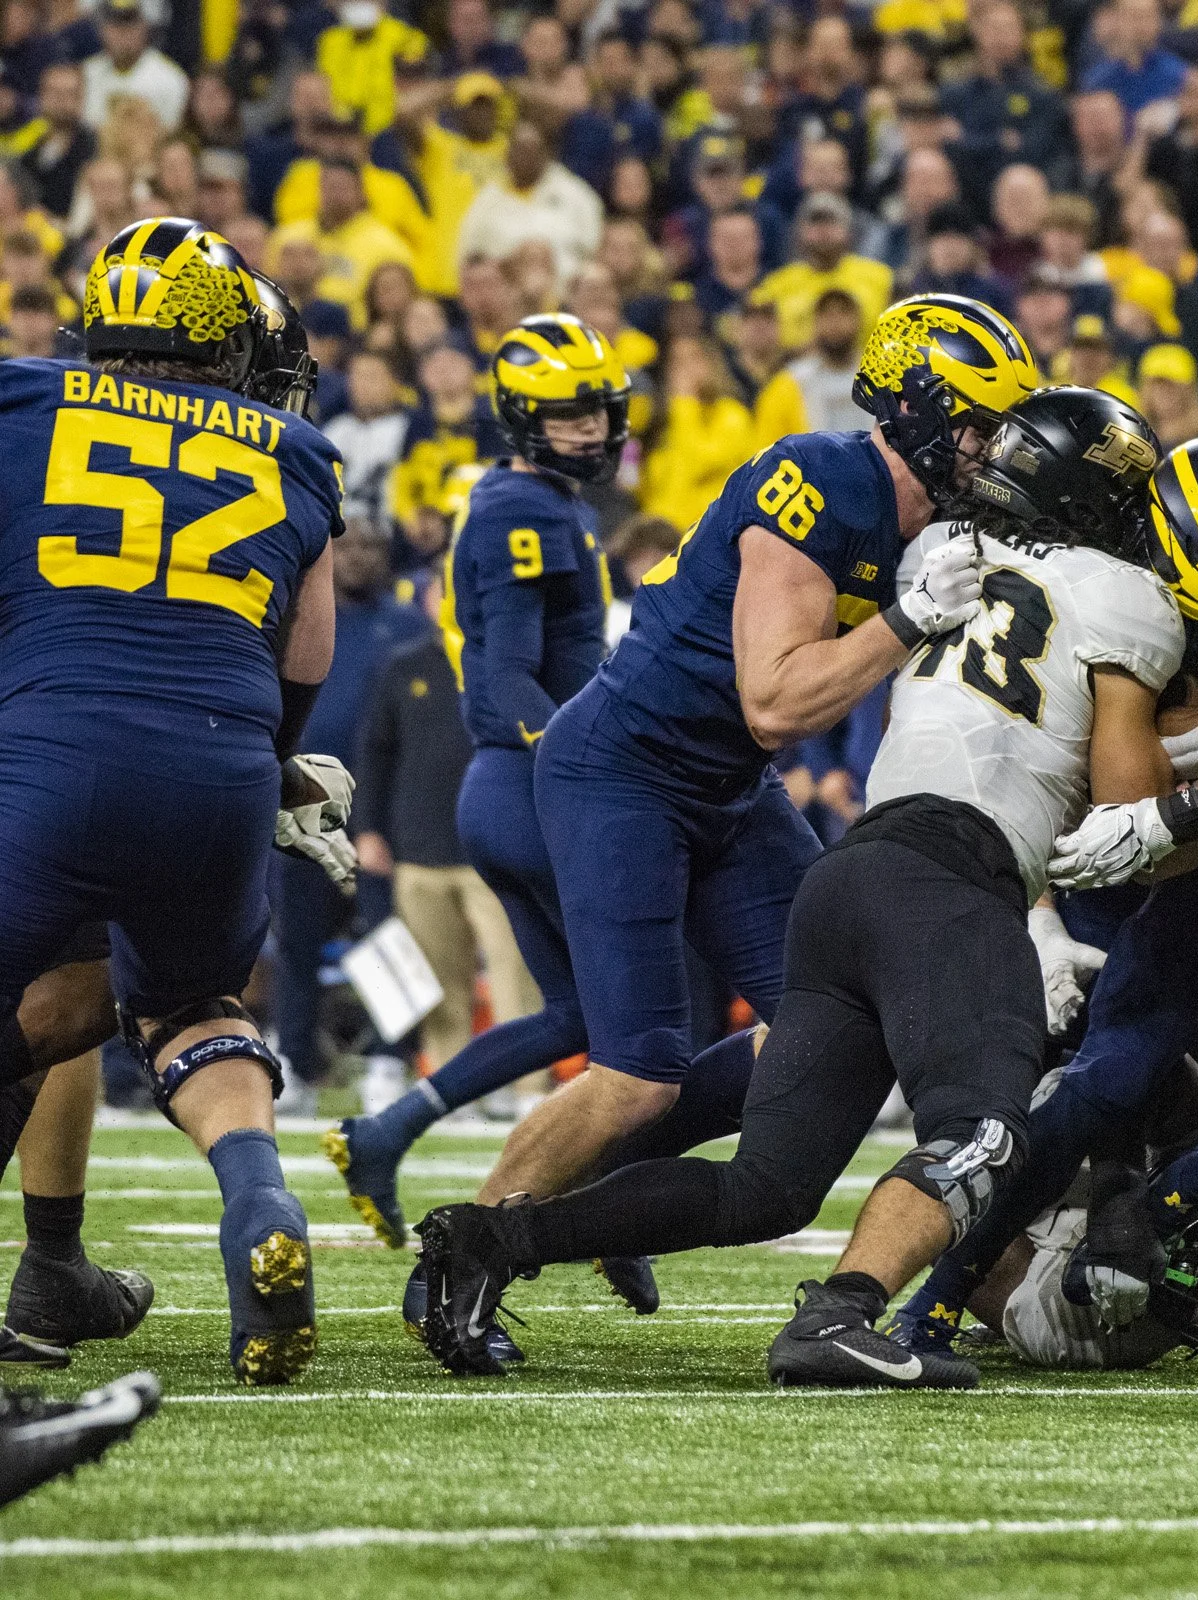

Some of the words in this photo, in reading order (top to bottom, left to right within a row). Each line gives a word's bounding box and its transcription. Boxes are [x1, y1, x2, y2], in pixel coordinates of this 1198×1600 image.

[63, 370, 286, 453] BARNHART
[1082, 422, 1158, 474] P
[37, 407, 287, 629] 52
[756, 459, 825, 541] 86
[508, 528, 544, 579] 9
[851, 560, 879, 582] BIG
[191, 1039, 248, 1060] DONJOY
[819, 1324, 847, 1337] ALPHA
[929, 1302, 958, 1327] M
